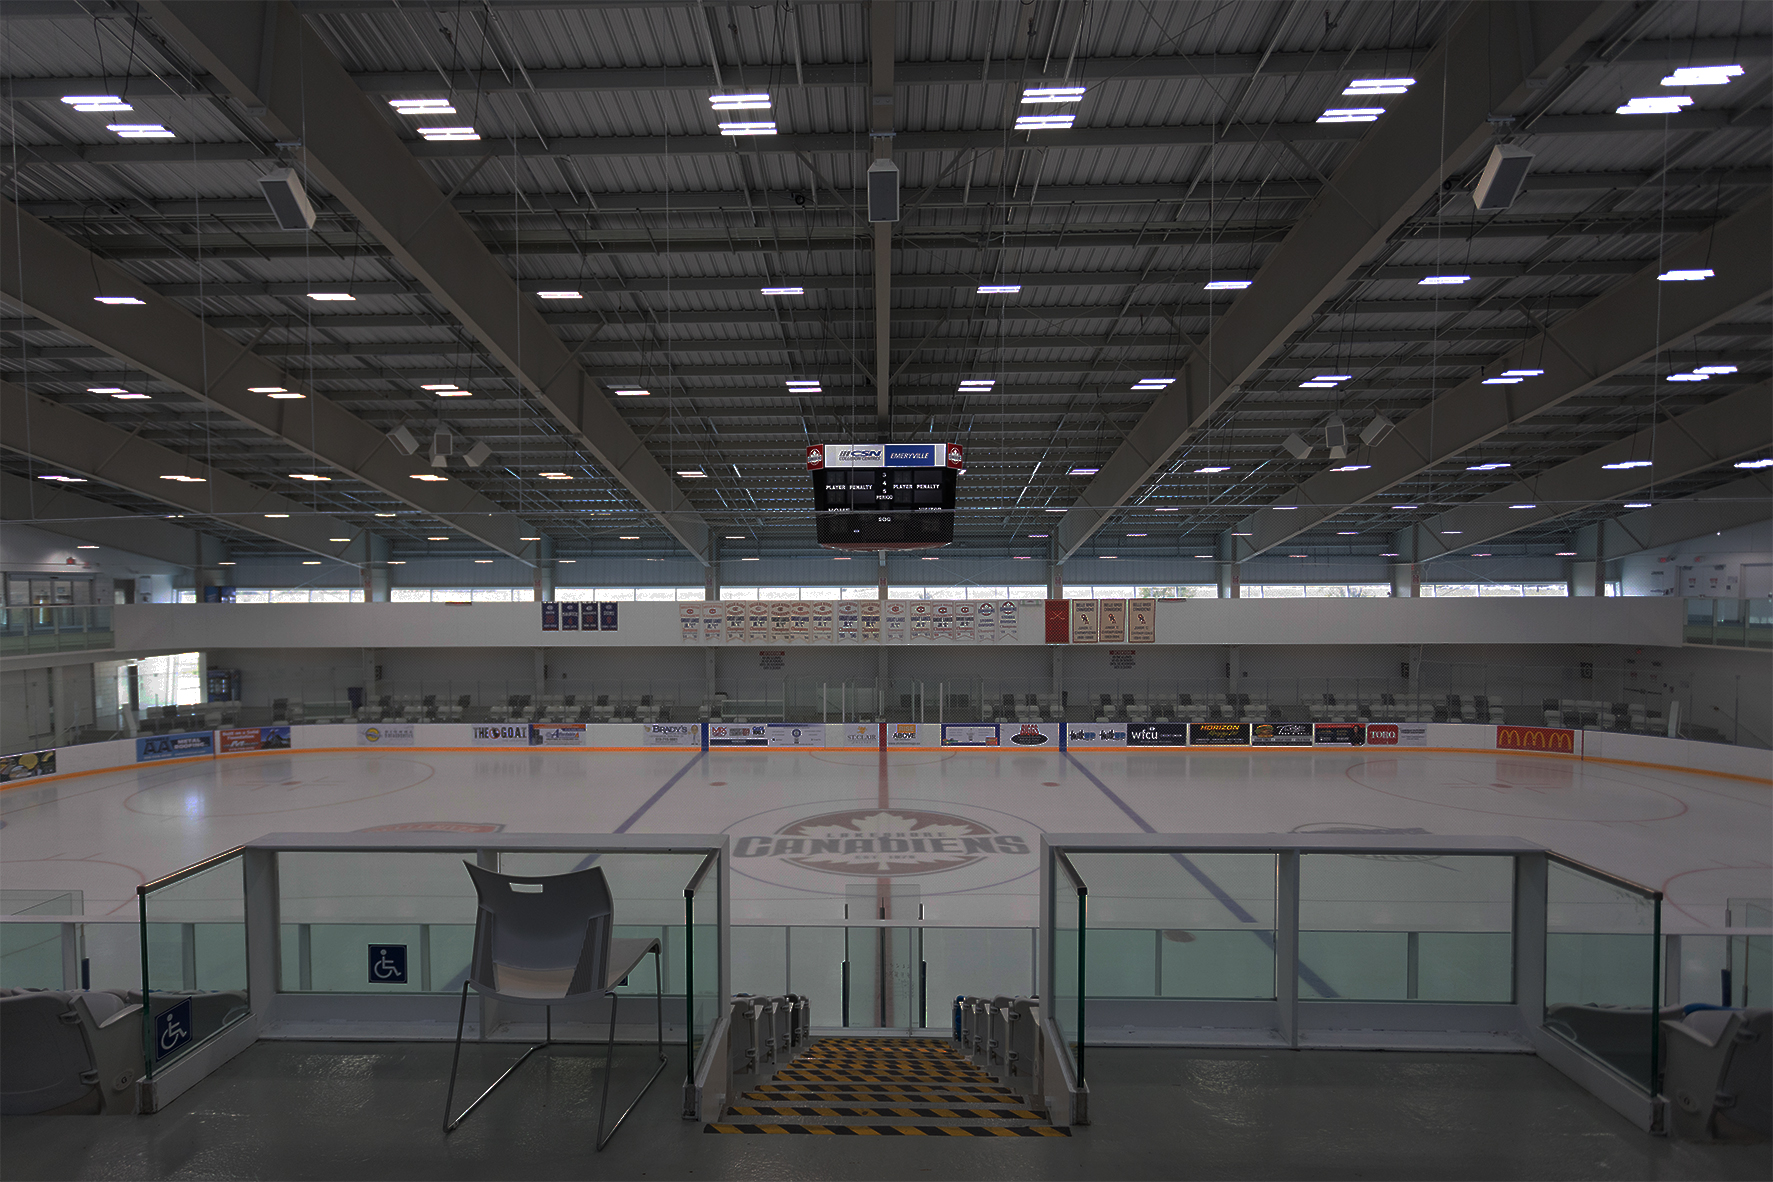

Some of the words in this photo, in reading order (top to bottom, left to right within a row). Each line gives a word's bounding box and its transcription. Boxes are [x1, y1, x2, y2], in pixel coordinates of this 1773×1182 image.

[472, 727, 489, 738] THE
[652, 725, 688, 734] BRADY'S
[1131, 729, 1158, 740] wfcu
[142, 740, 172, 755] AA
[732, 835, 1030, 858] CANADIENS
